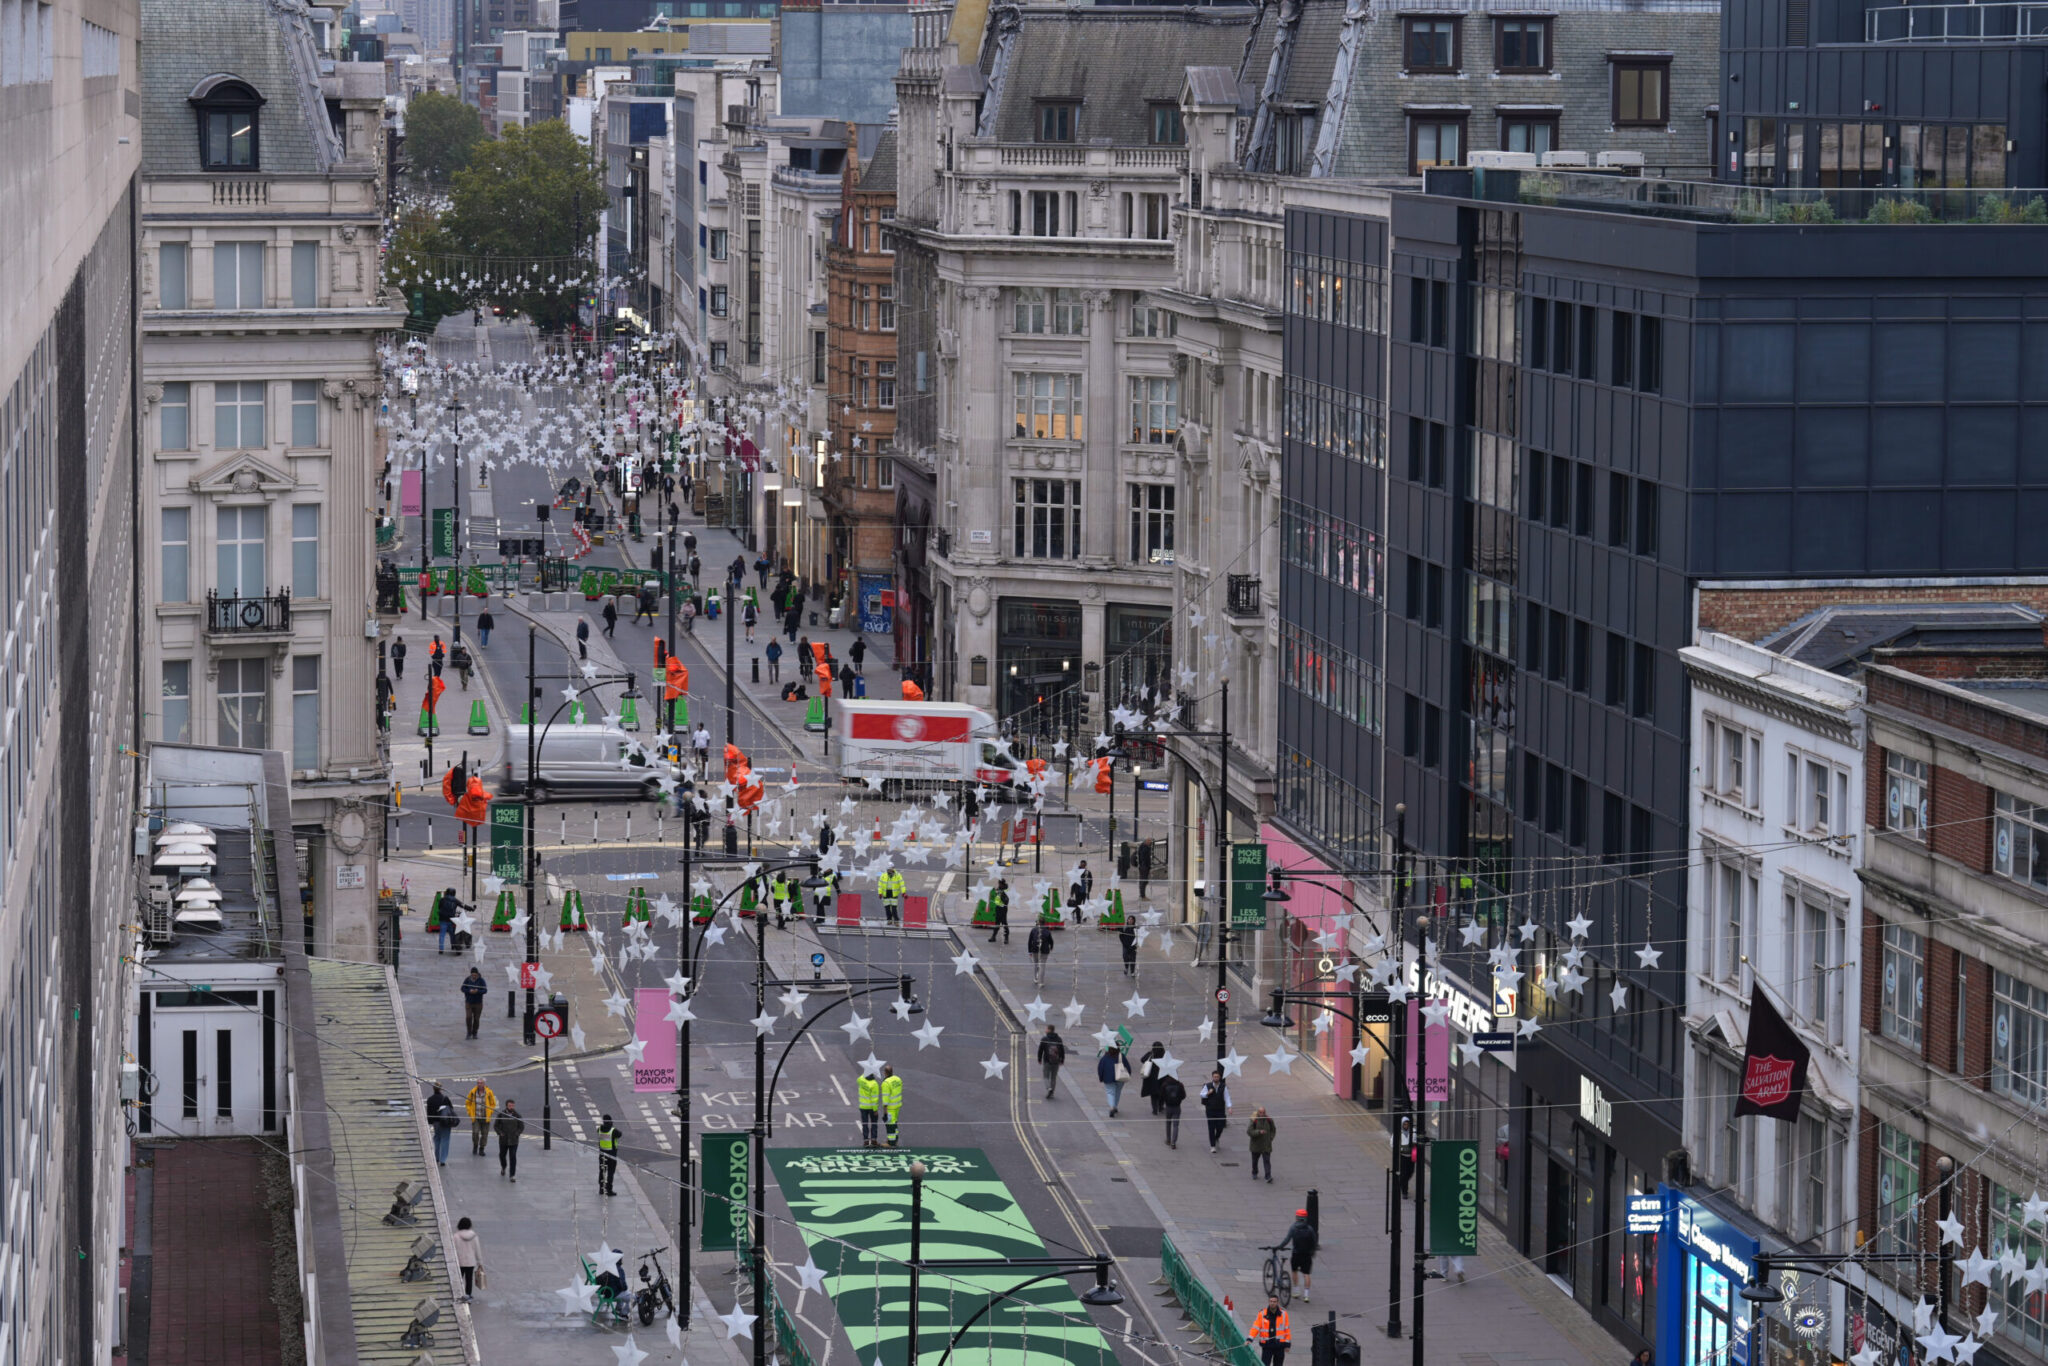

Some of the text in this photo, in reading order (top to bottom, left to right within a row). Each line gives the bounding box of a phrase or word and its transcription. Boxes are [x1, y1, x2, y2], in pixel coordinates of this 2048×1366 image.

[444, 512, 452, 548] OXFORD
[1238, 849, 1262, 857] MORE
[1238, 857, 1262, 865] SPACE
[1233, 916, 1265, 924] TRAFFIC
[635, 1069, 666, 1077] MAYOR
[1756, 1062, 1772, 1073] THE
[635, 1077, 674, 1085] LONDON
[1746, 1067, 1789, 1091] SALVATION
[1757, 1081, 1784, 1098] ARMY
[700, 1090, 801, 1107] KEEP
[701, 1112, 833, 1129] CLEAR
[805, 1166, 965, 1174] WLCOME
[729, 1141, 748, 1227] OXFORD
[1459, 1148, 1478, 1233] OXFORD
[1631, 1199, 1661, 1210] atm
[1628, 1214, 1663, 1223] Change
[1630, 1223, 1661, 1233] Money
[1691, 1223, 1721, 1262] Change
[1722, 1243, 1749, 1284] Money
[1868, 1322, 1895, 1354] REGENT
